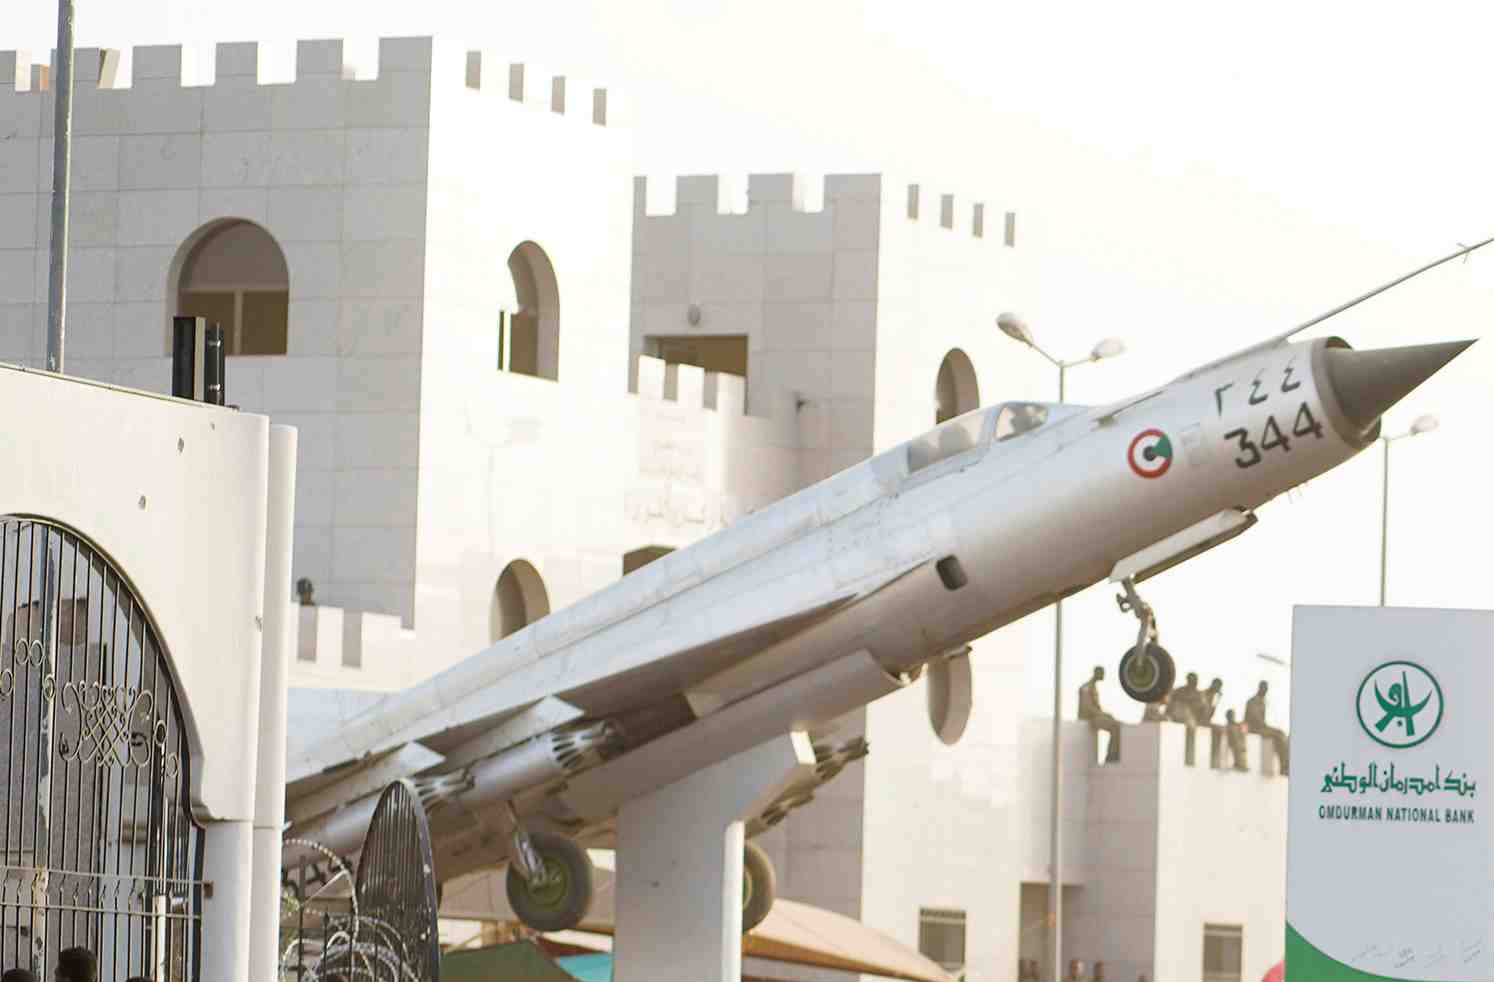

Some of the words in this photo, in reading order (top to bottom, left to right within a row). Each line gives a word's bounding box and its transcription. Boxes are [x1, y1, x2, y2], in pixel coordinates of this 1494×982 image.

[1224, 401, 1324, 469] 344
[1443, 767, 1477, 798] بنك
[1318, 804, 1383, 821] OMDURMAN
[1386, 806, 1441, 823] NATIONAL
[1445, 807, 1475, 823] BANK
